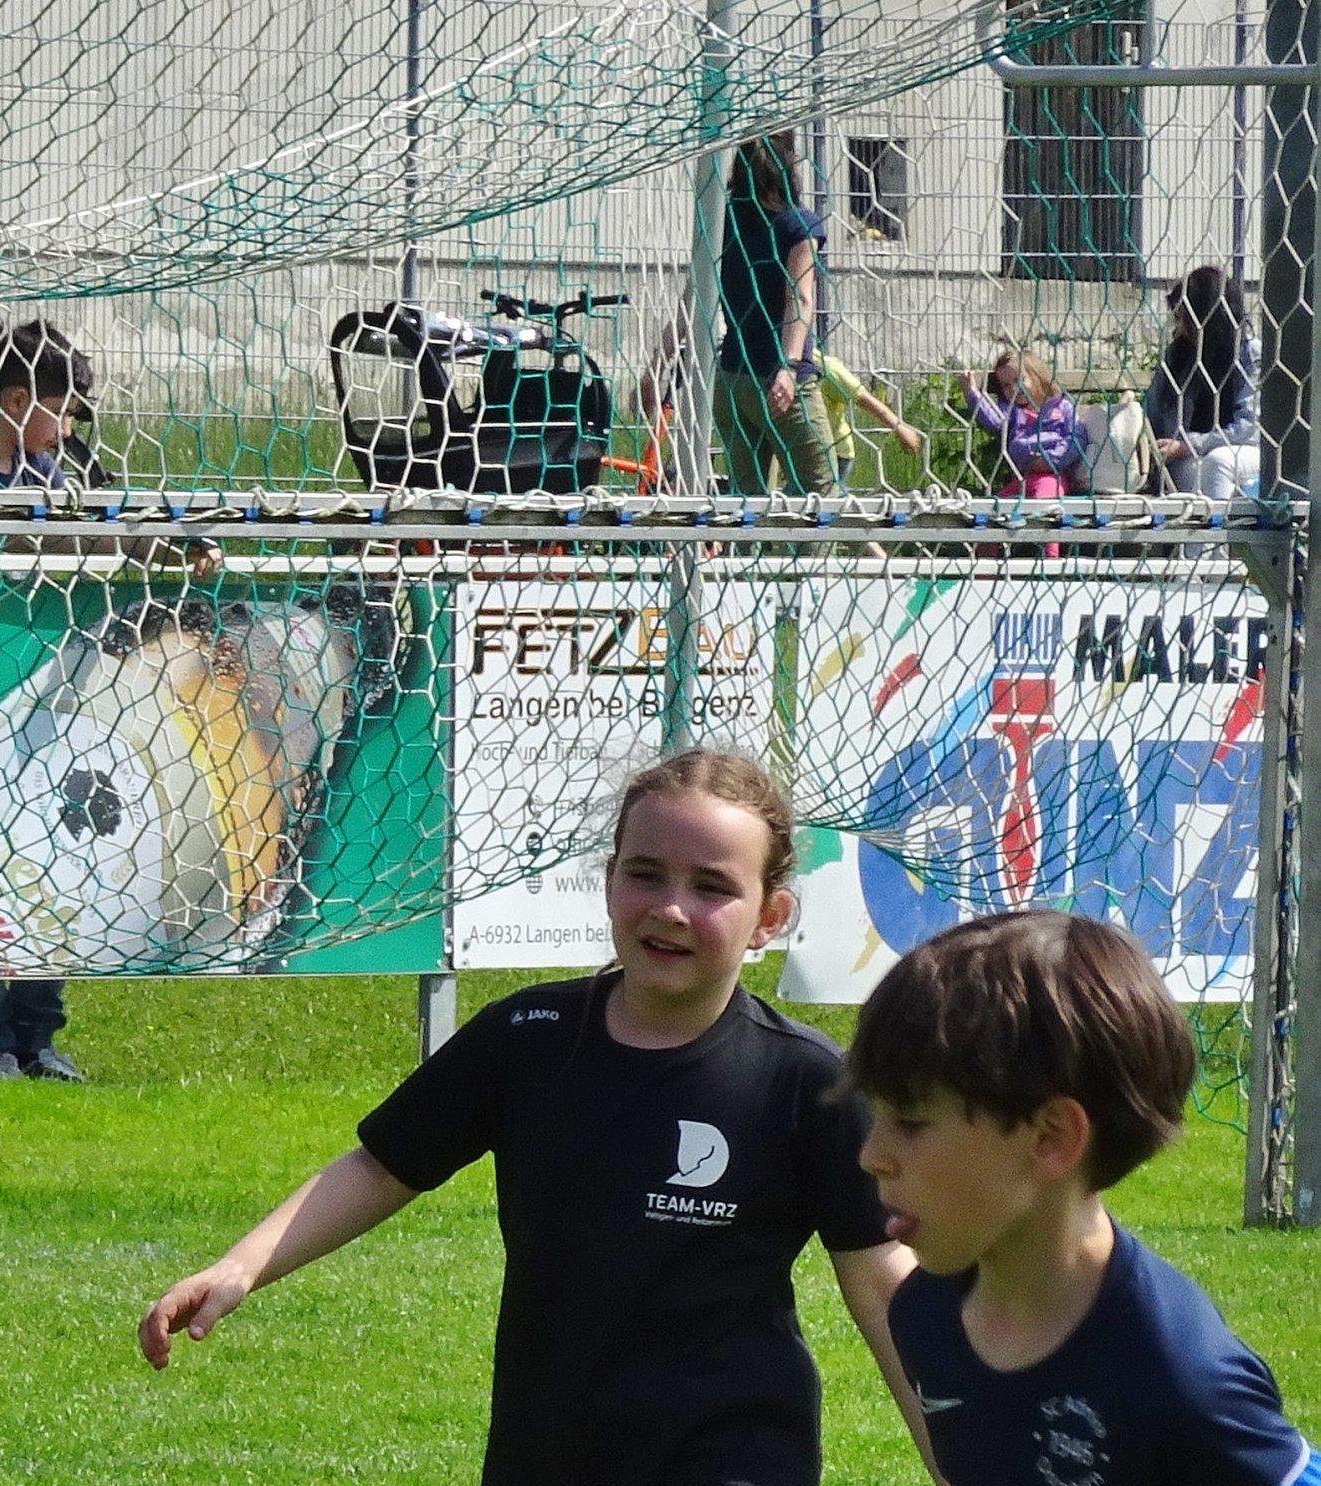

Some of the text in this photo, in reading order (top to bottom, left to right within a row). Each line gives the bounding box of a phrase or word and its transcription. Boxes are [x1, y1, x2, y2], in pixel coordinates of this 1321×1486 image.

[642, 688, 758, 725] Bgenz
[552, 741, 601, 760] Tiefba
[556, 877, 605, 893] www.
[470, 925, 521, 944] A-6932
[526, 923, 581, 949] Langen
[527, 1009, 559, 1021] JAKO
[646, 1193, 738, 1218] TEAM-VRZ
